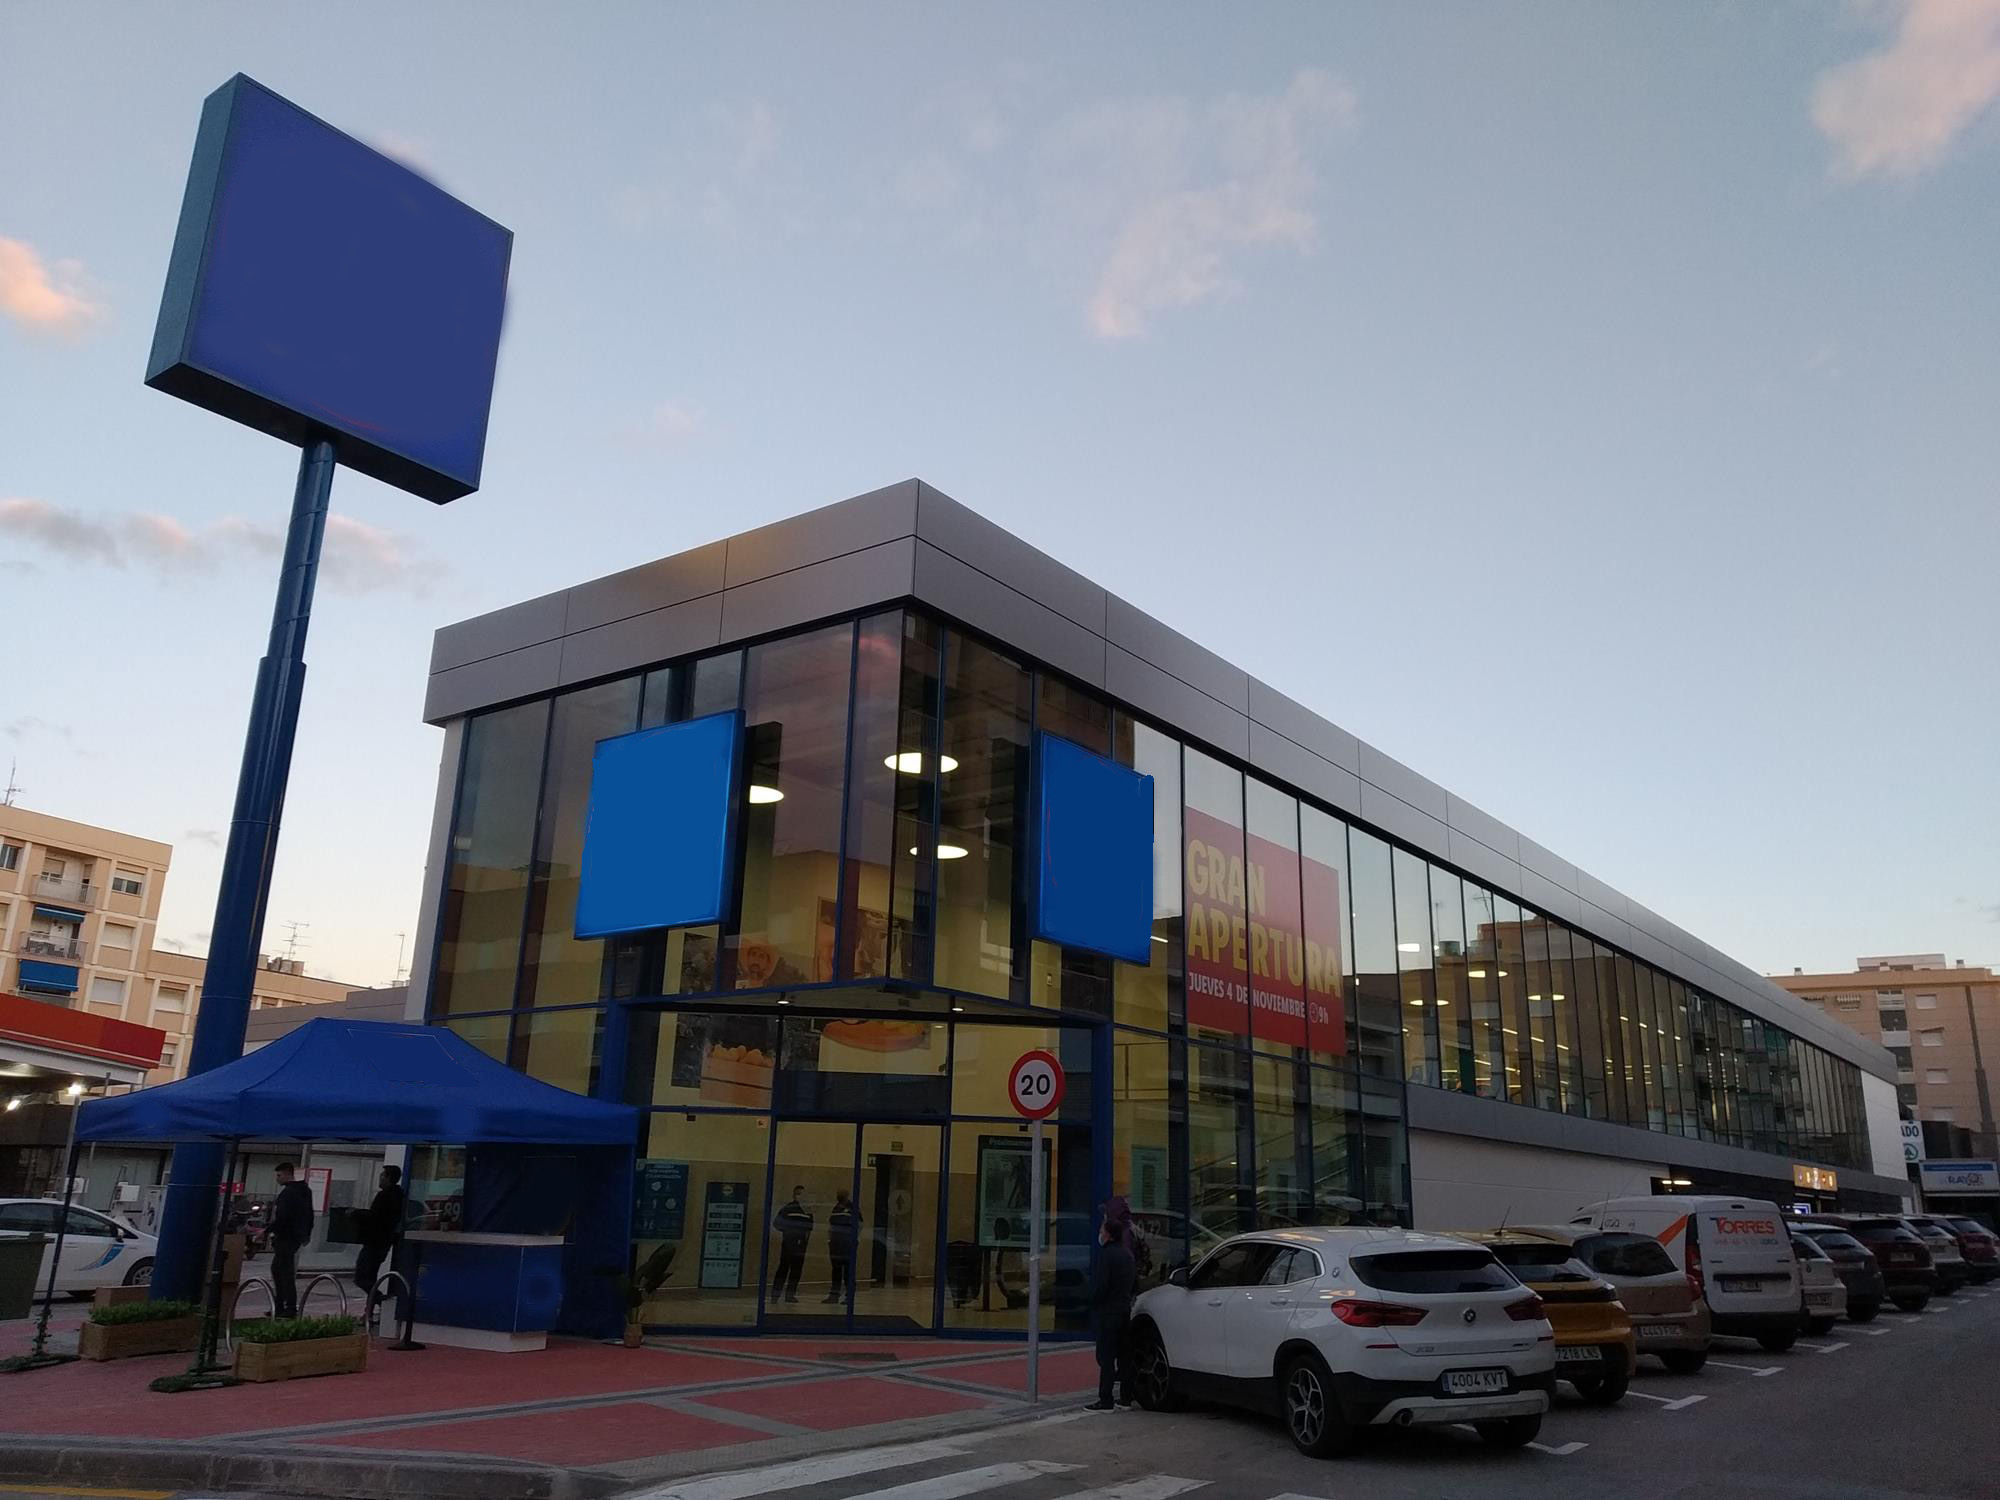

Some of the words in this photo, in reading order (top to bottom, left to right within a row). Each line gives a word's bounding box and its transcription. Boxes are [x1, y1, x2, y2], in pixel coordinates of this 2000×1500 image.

[1187, 839, 1266, 917] GRAN
[1187, 903, 1341, 998] APERTURA
[1189, 972, 1225, 999] JUEVES
[1226, 982, 1233, 1000] 4
[1236, 984, 1249, 1005] DE
[1253, 989, 1306, 1018] NOVIEMBRE
[1021, 1074, 1051, 1096] 20
[1710, 1216, 1776, 1234] TORRES
[1451, 1374, 1481, 1388] 4004
[1484, 1371, 1504, 1386] KVT
